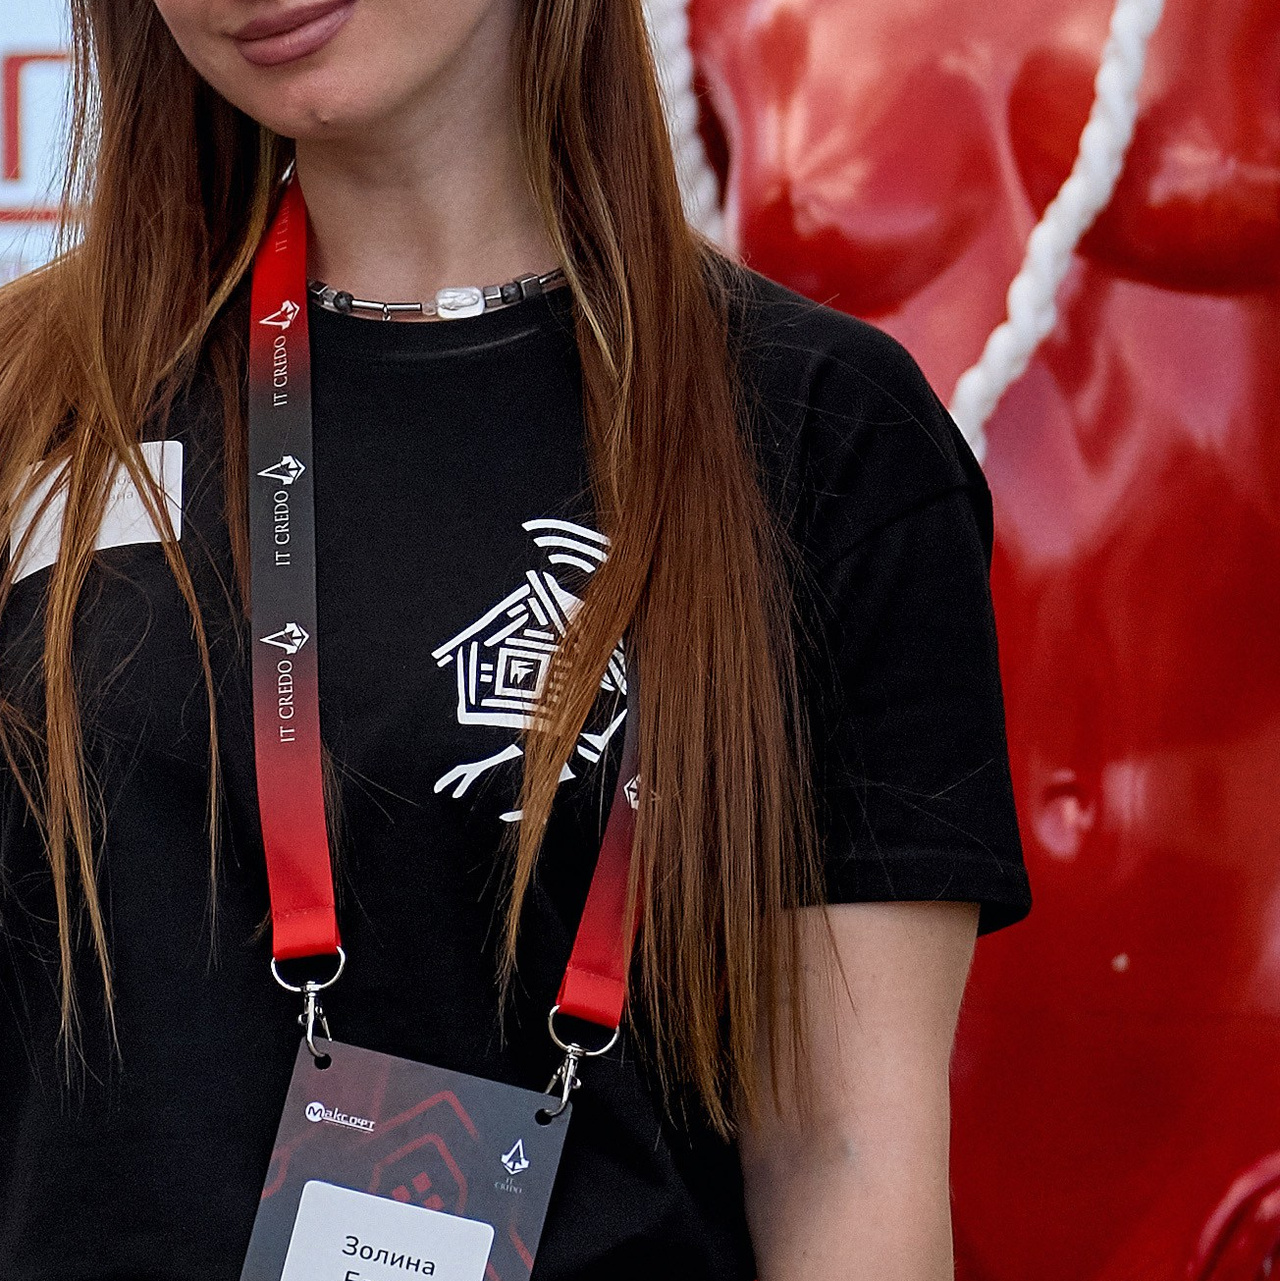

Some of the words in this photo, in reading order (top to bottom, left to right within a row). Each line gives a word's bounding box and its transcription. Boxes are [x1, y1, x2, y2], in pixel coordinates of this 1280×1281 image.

[273, 335, 288, 388] CREDO
[273, 392, 288, 408] IT
[274, 490, 290, 545] CREDO
[275, 551, 291, 566] IT
[277, 659, 295, 720] CREDO
[279, 725, 296, 743] IT
[341, 1235, 436, 1276] Золина
